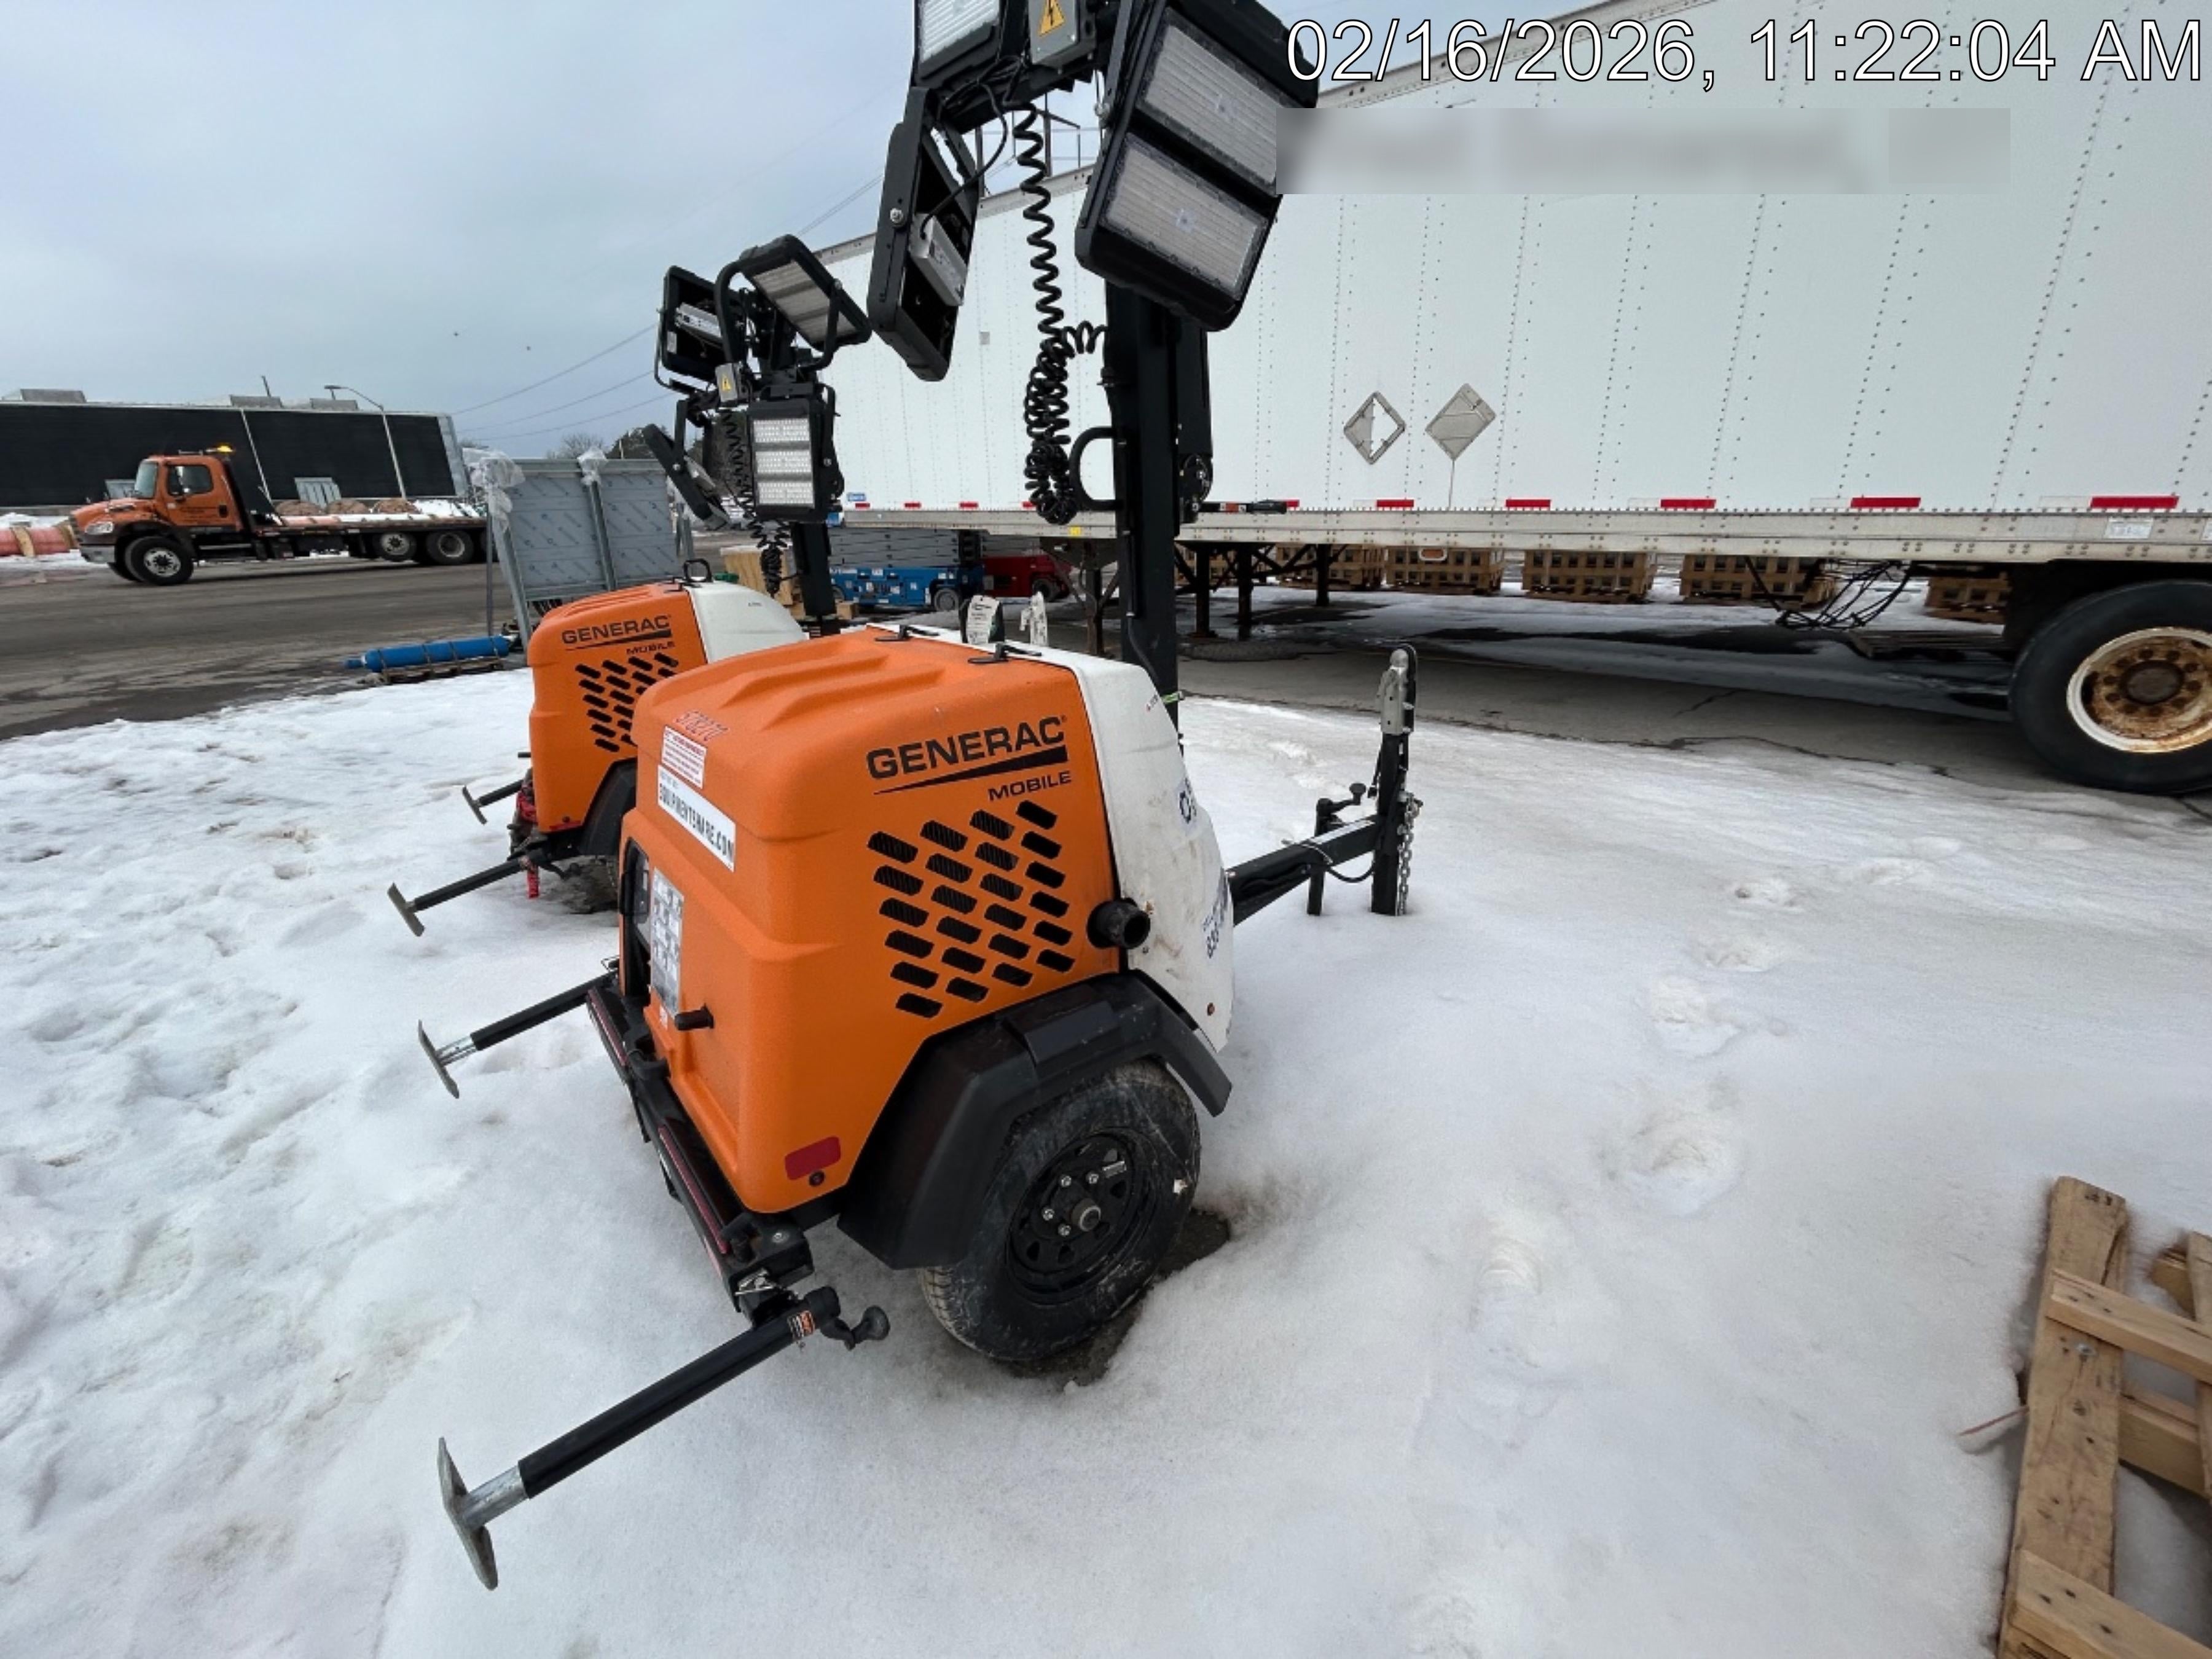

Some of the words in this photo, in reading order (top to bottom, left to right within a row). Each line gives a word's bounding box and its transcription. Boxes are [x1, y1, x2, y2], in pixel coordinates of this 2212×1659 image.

[562, 615, 670, 644] GENERAC
[866, 716, 1065, 780] GENERAC
[988, 770, 1072, 800] MOBILE
